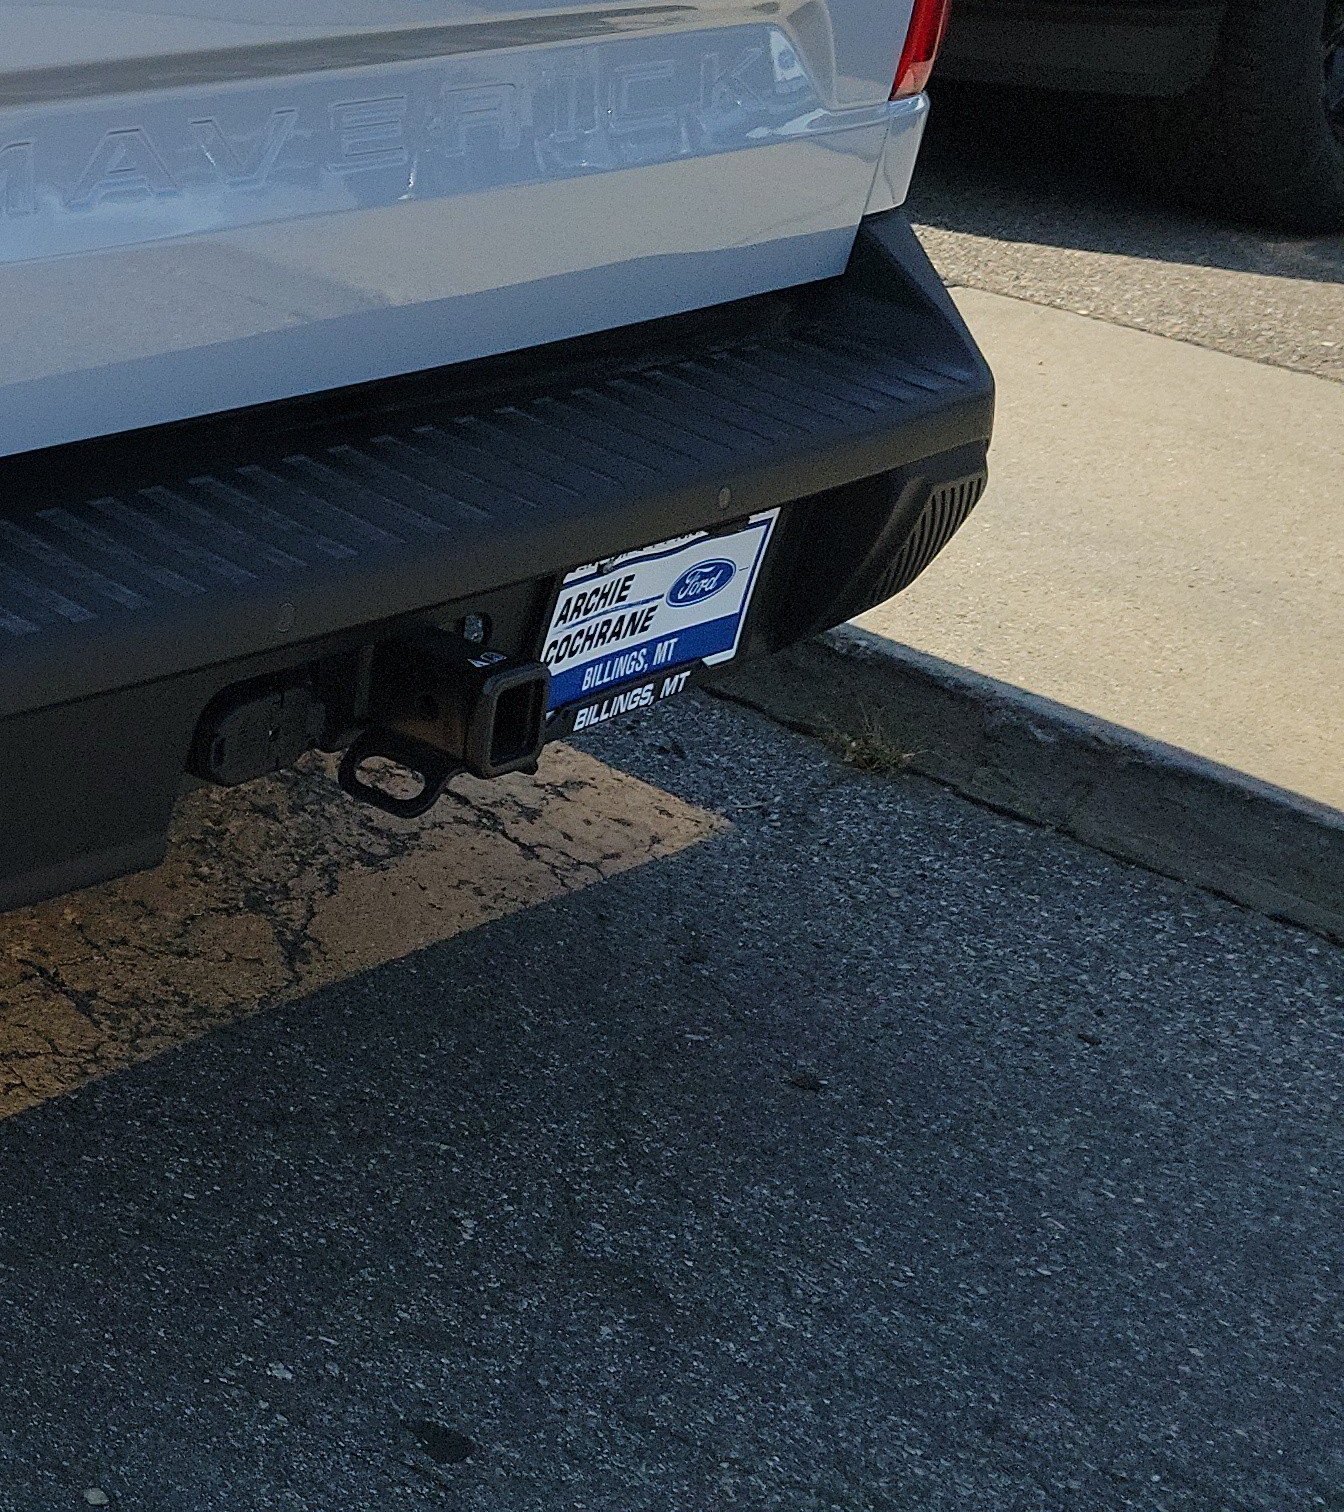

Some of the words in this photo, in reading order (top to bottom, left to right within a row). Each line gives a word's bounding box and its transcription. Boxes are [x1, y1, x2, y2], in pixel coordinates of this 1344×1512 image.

[553, 574, 636, 628] ARCHIE
[677, 567, 724, 600] Ford
[544, 605, 659, 667] COCHRANE
[582, 644, 649, 692] BILLINGS,
[653, 638, 679, 666] MT
[572, 682, 654, 732] BILLINGS,
[659, 671, 691, 699] MT
